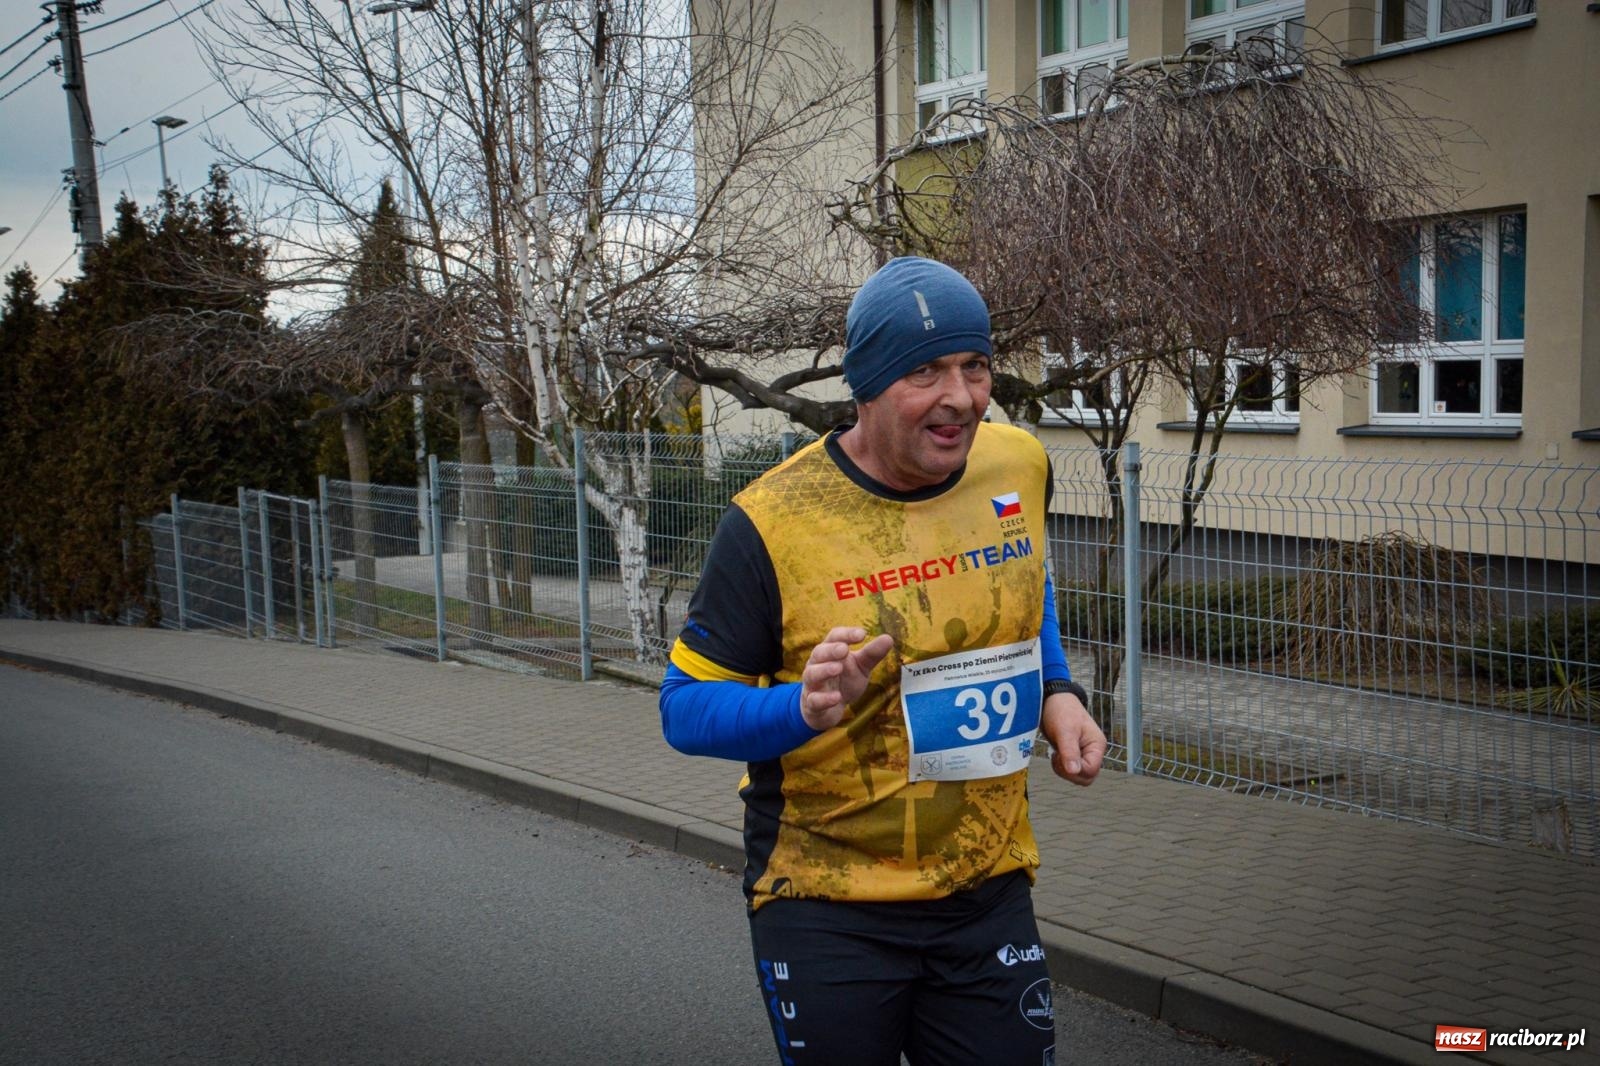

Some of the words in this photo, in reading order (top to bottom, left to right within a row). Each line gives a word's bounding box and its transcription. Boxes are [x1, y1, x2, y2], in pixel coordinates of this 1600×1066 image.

[1000, 517, 1025, 529] CZECH
[1003, 526, 1028, 539] REPUBLIC
[833, 554, 958, 601] ENERGY
[965, 537, 1033, 569] TEAM
[922, 666, 937, 675] Eko
[938, 661, 962, 672] Cross
[963, 659, 974, 670] po
[975, 655, 998, 666] Ziemi
[954, 681, 1018, 741] 39
